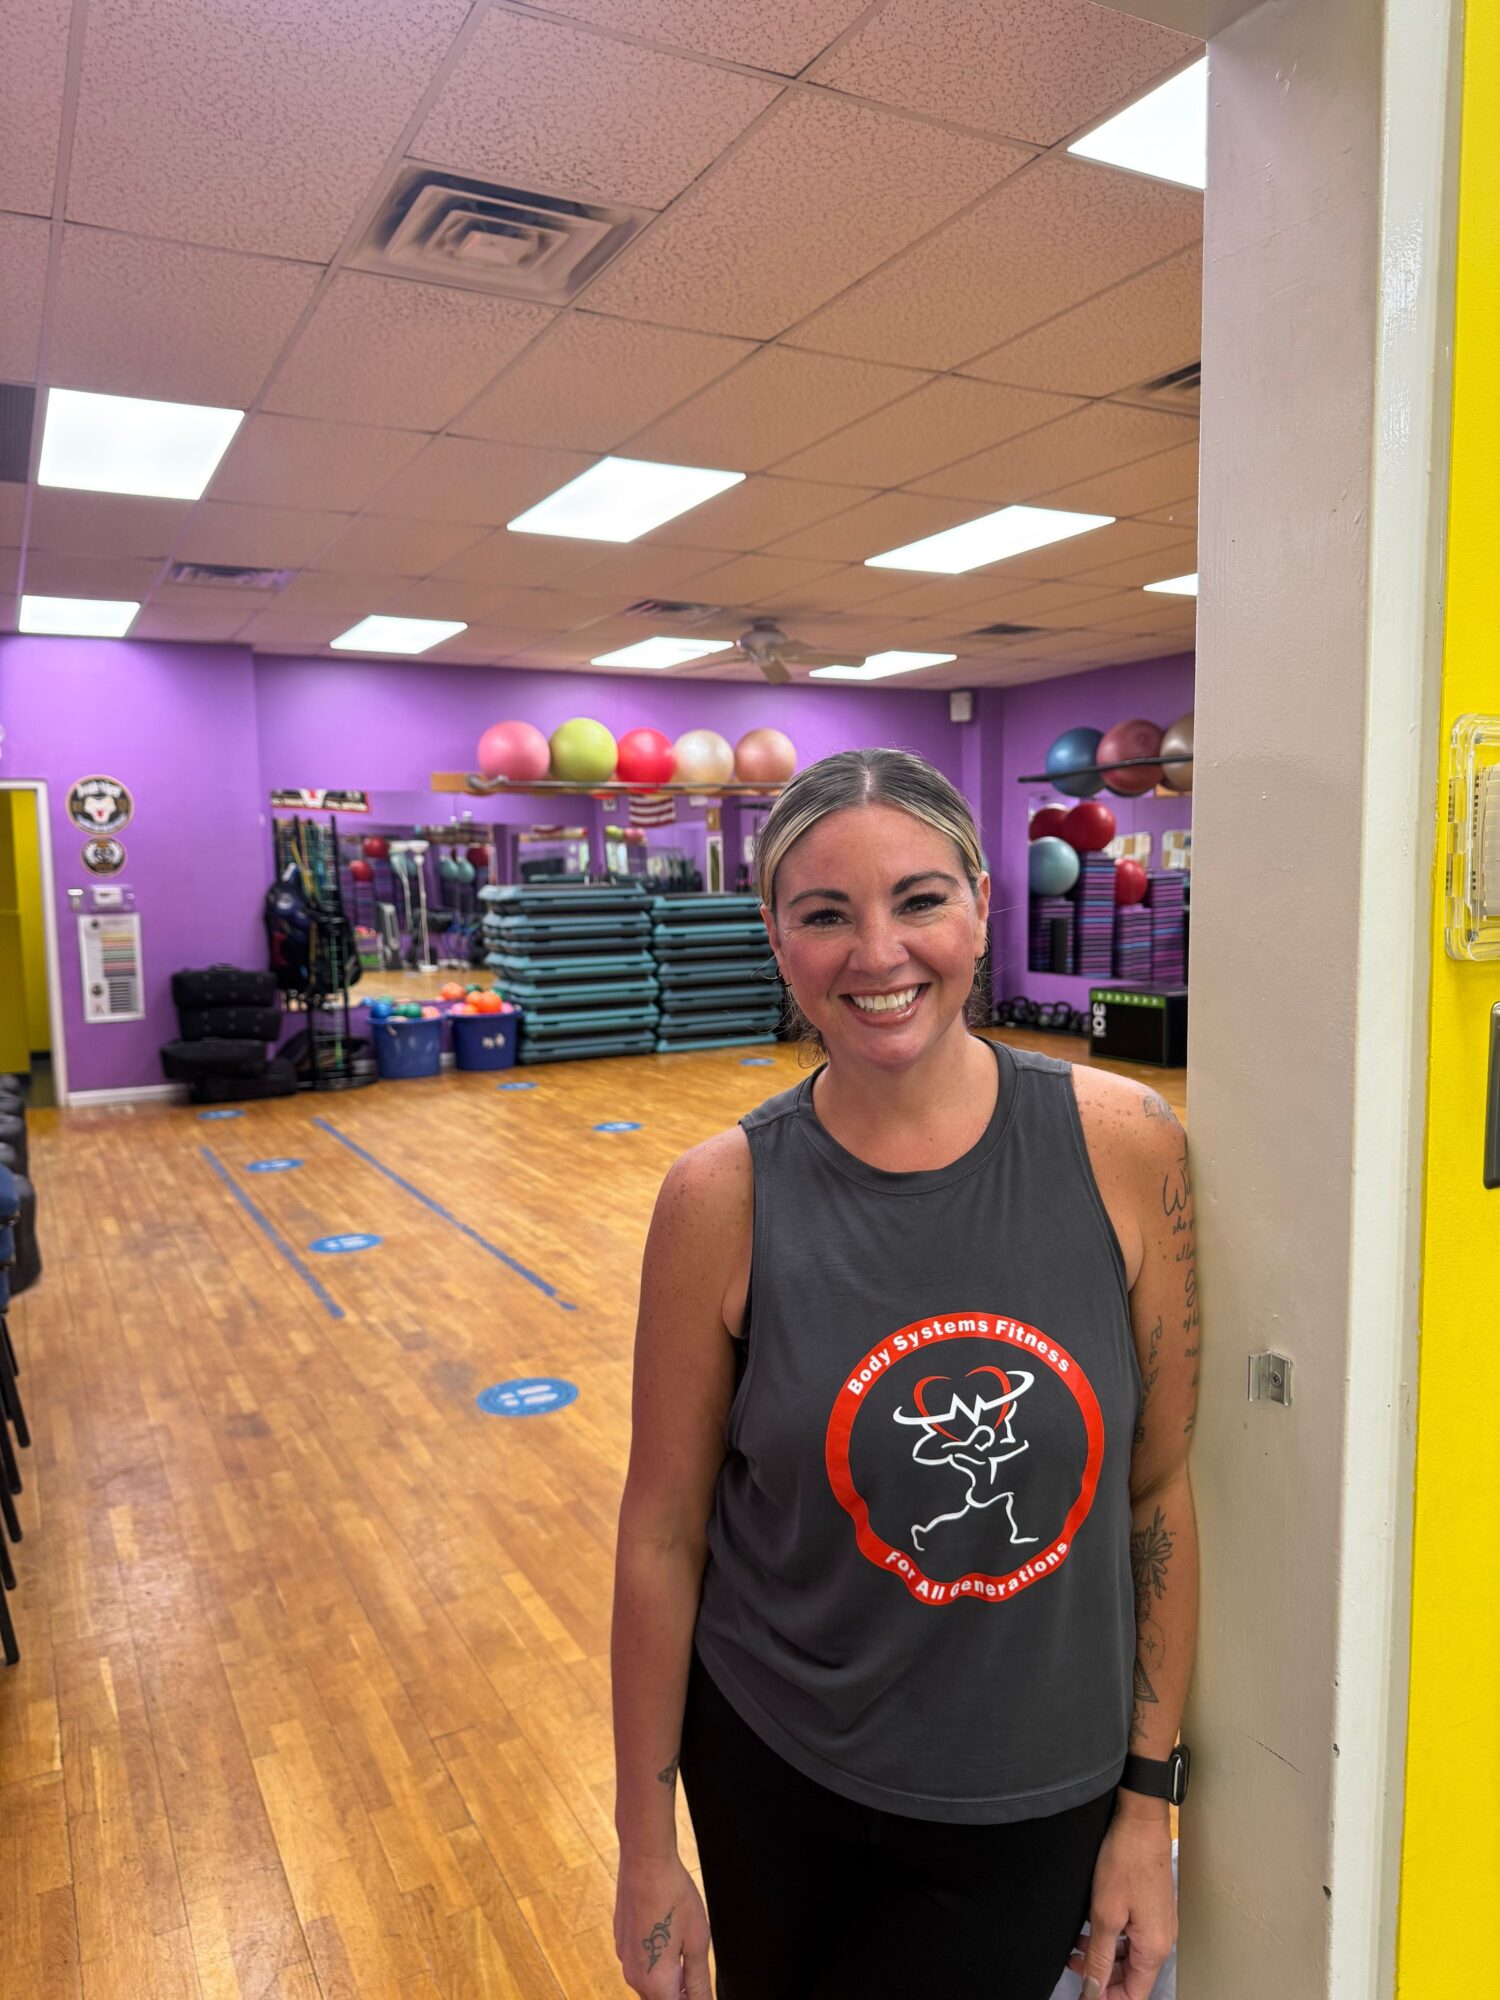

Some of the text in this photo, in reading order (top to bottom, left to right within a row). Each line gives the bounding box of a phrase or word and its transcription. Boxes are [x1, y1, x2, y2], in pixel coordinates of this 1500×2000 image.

[847, 1318, 1070, 1396] Body Systems Fitness
[885, 1541, 1068, 1600] For All Generations
